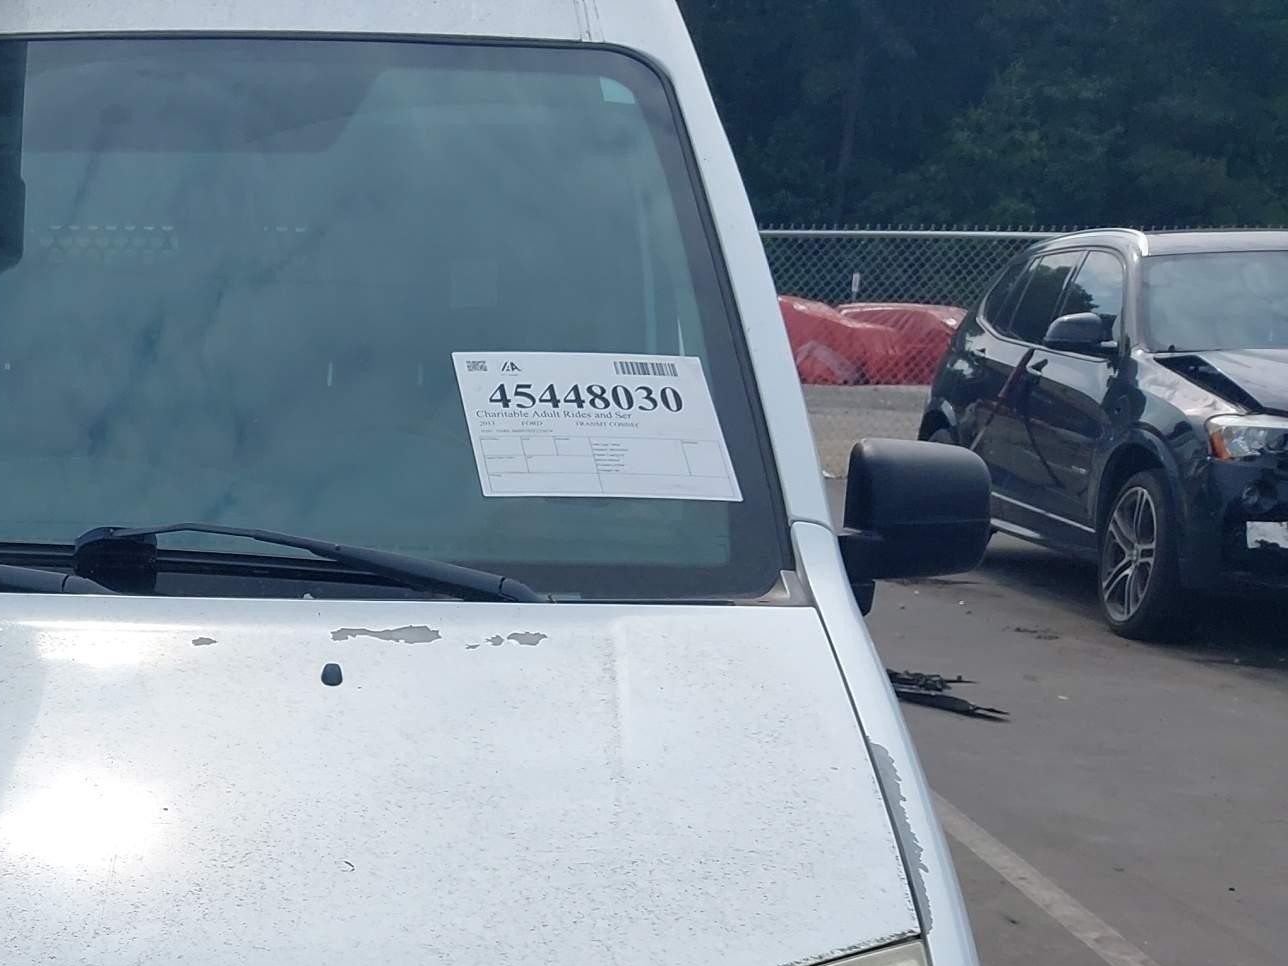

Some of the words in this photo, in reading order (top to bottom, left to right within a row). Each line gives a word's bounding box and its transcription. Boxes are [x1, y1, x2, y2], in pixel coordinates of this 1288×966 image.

[489, 383, 683, 413] 45448030
[476, 410, 529, 419] Charitable
[532, 410, 560, 419] Adult
[563, 410, 592, 419] Rides
[594, 411, 613, 419] and
